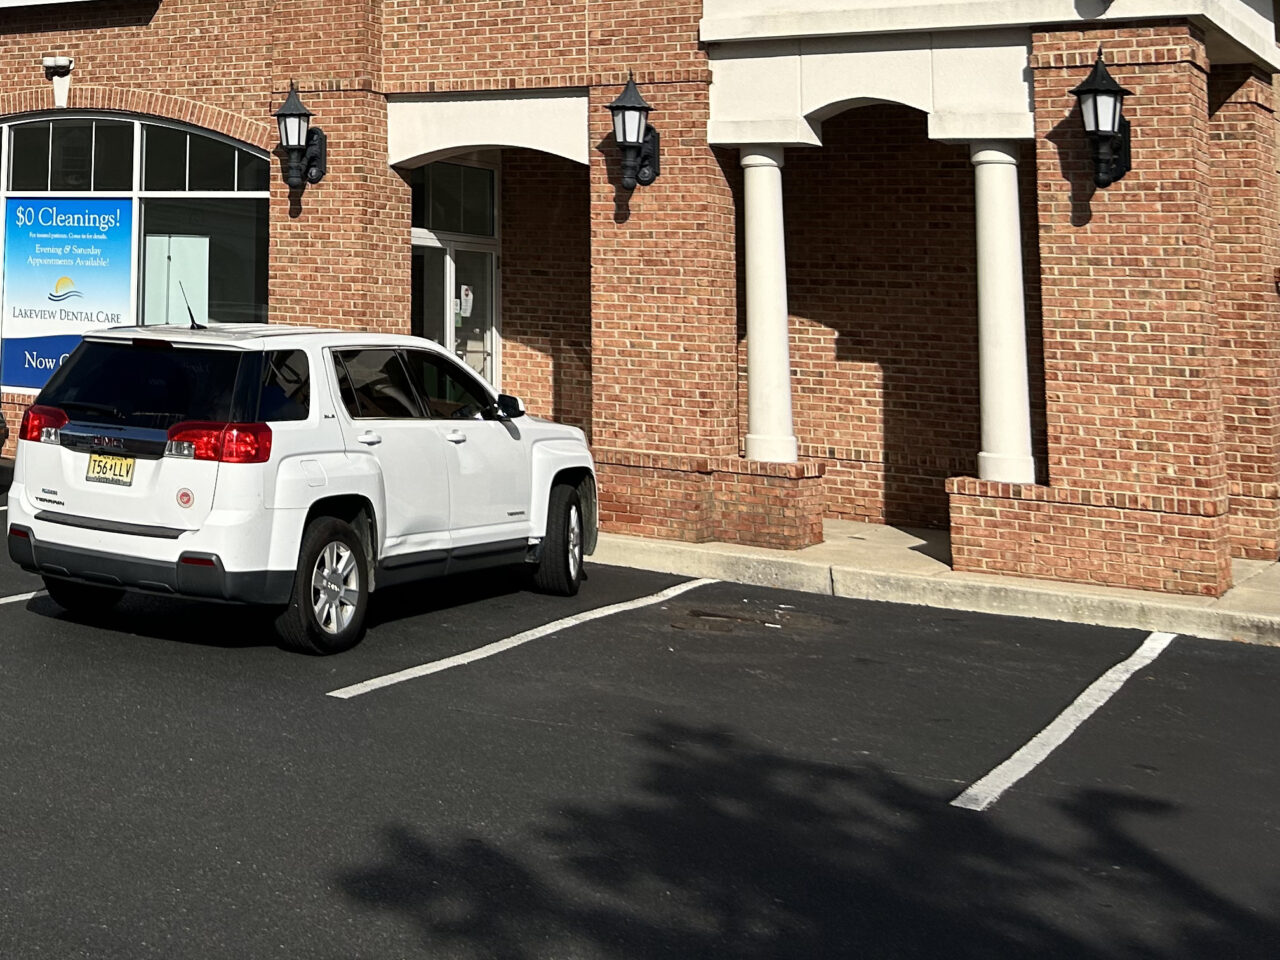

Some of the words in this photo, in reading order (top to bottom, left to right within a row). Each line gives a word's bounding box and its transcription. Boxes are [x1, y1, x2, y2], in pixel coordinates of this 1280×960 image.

[15, 205, 35, 228] $0
[38, 206, 120, 232] Cleanings!
[35, 243, 62, 255] Evening
[72, 244, 102, 257] Saturday
[27, 256, 73, 267] Appointments
[75, 257, 110, 267] Available!
[12, 306, 57, 320] LAKEVIEW
[59, 308, 95, 322] DENTAL
[96, 310, 122, 324] CARE
[24, 351, 56, 370] Now
[34, 496, 65, 506] TERRAIN
